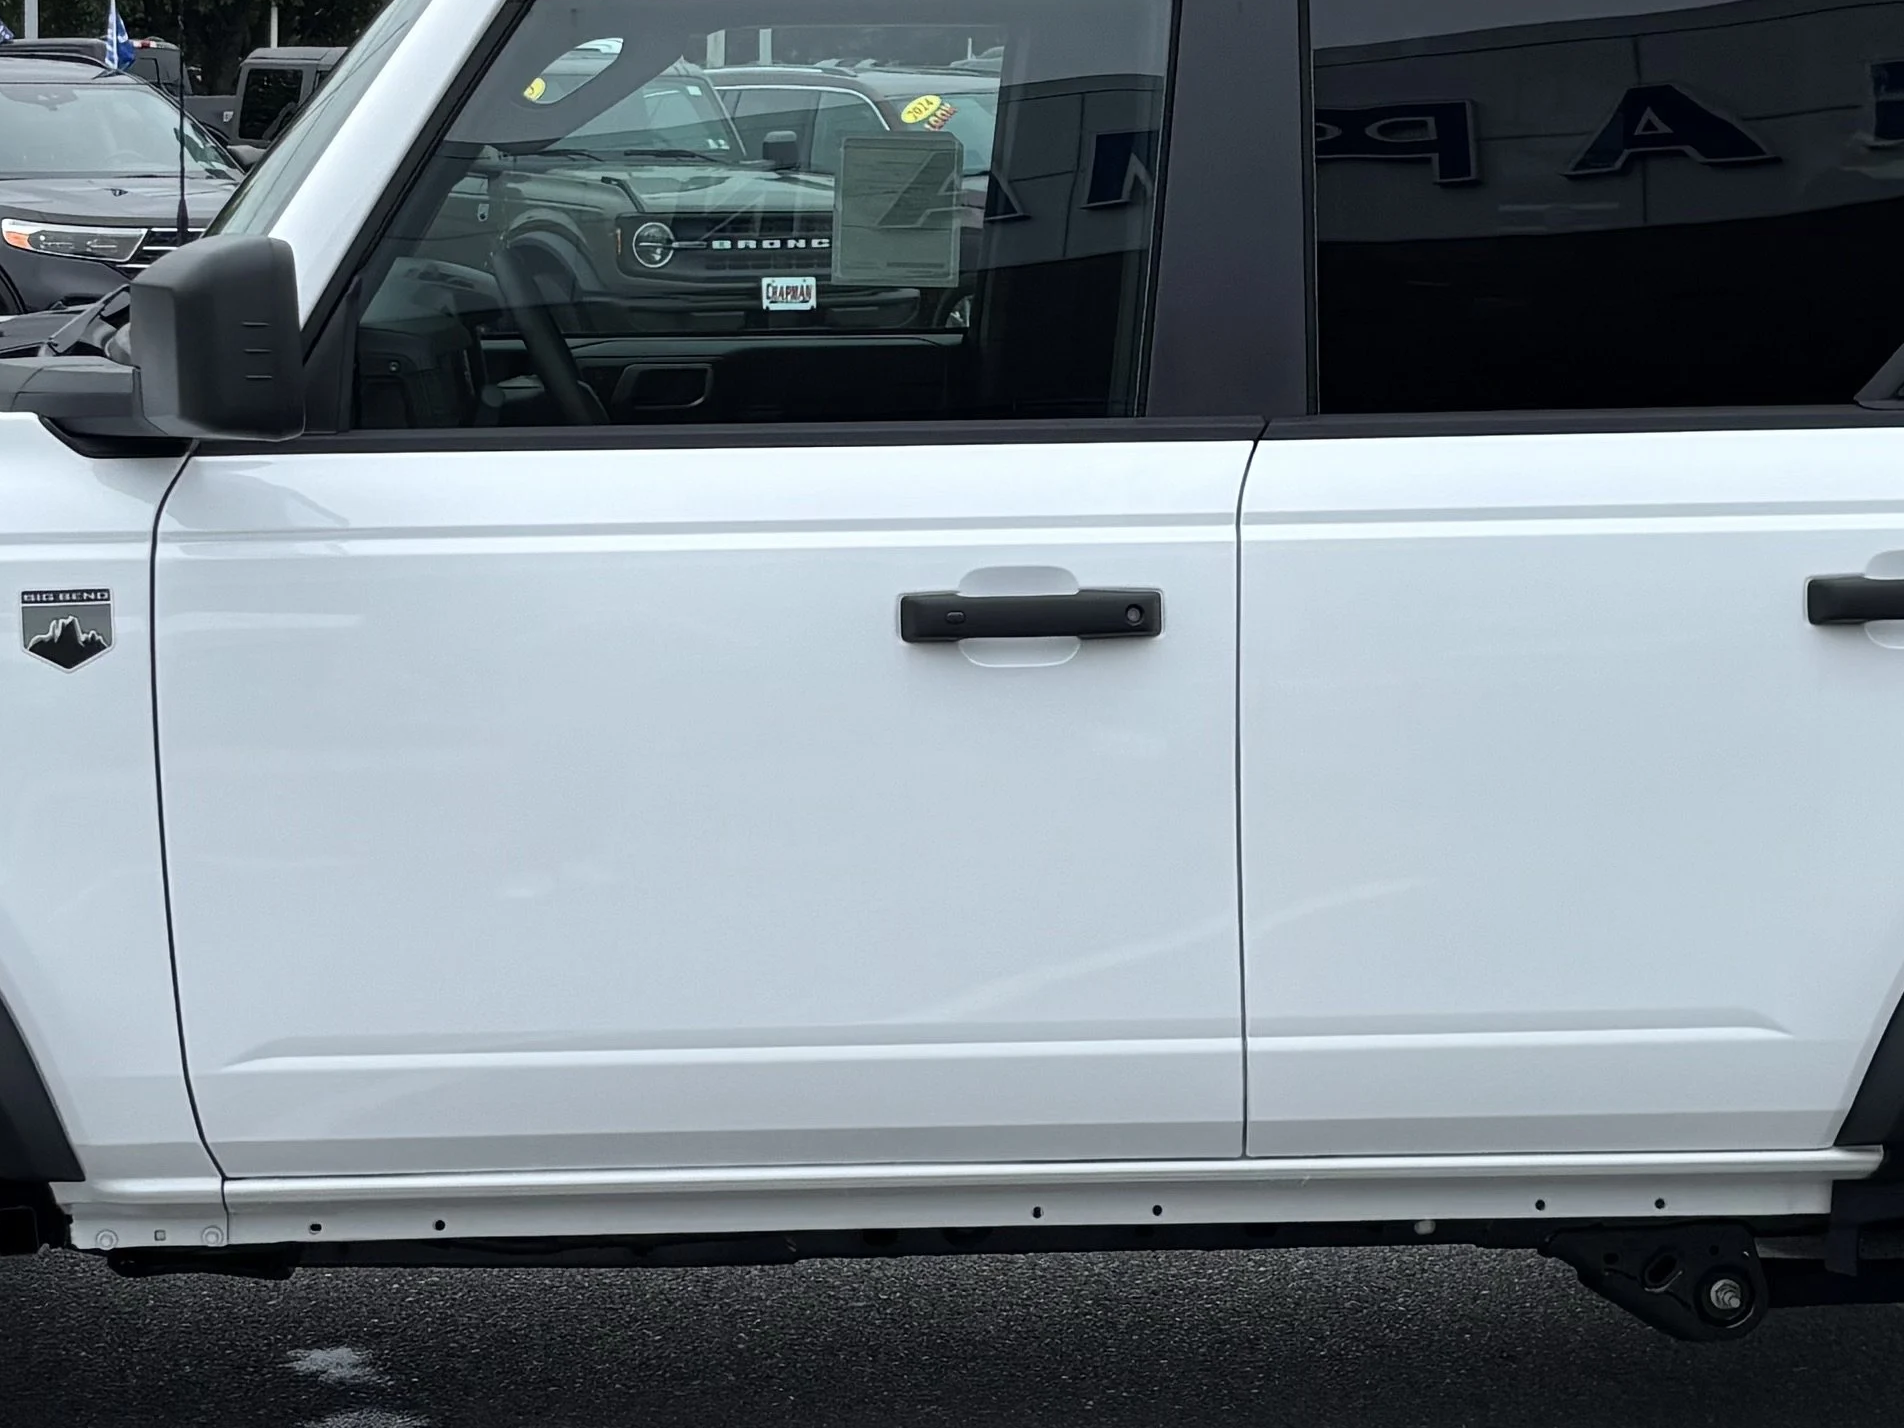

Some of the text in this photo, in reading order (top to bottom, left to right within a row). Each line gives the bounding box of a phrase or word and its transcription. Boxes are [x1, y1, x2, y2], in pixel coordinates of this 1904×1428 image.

[712, 239, 831, 249] BRONC
[766, 283, 813, 302] CHAPMAN
[22, 591, 109, 602] BIG BEND
